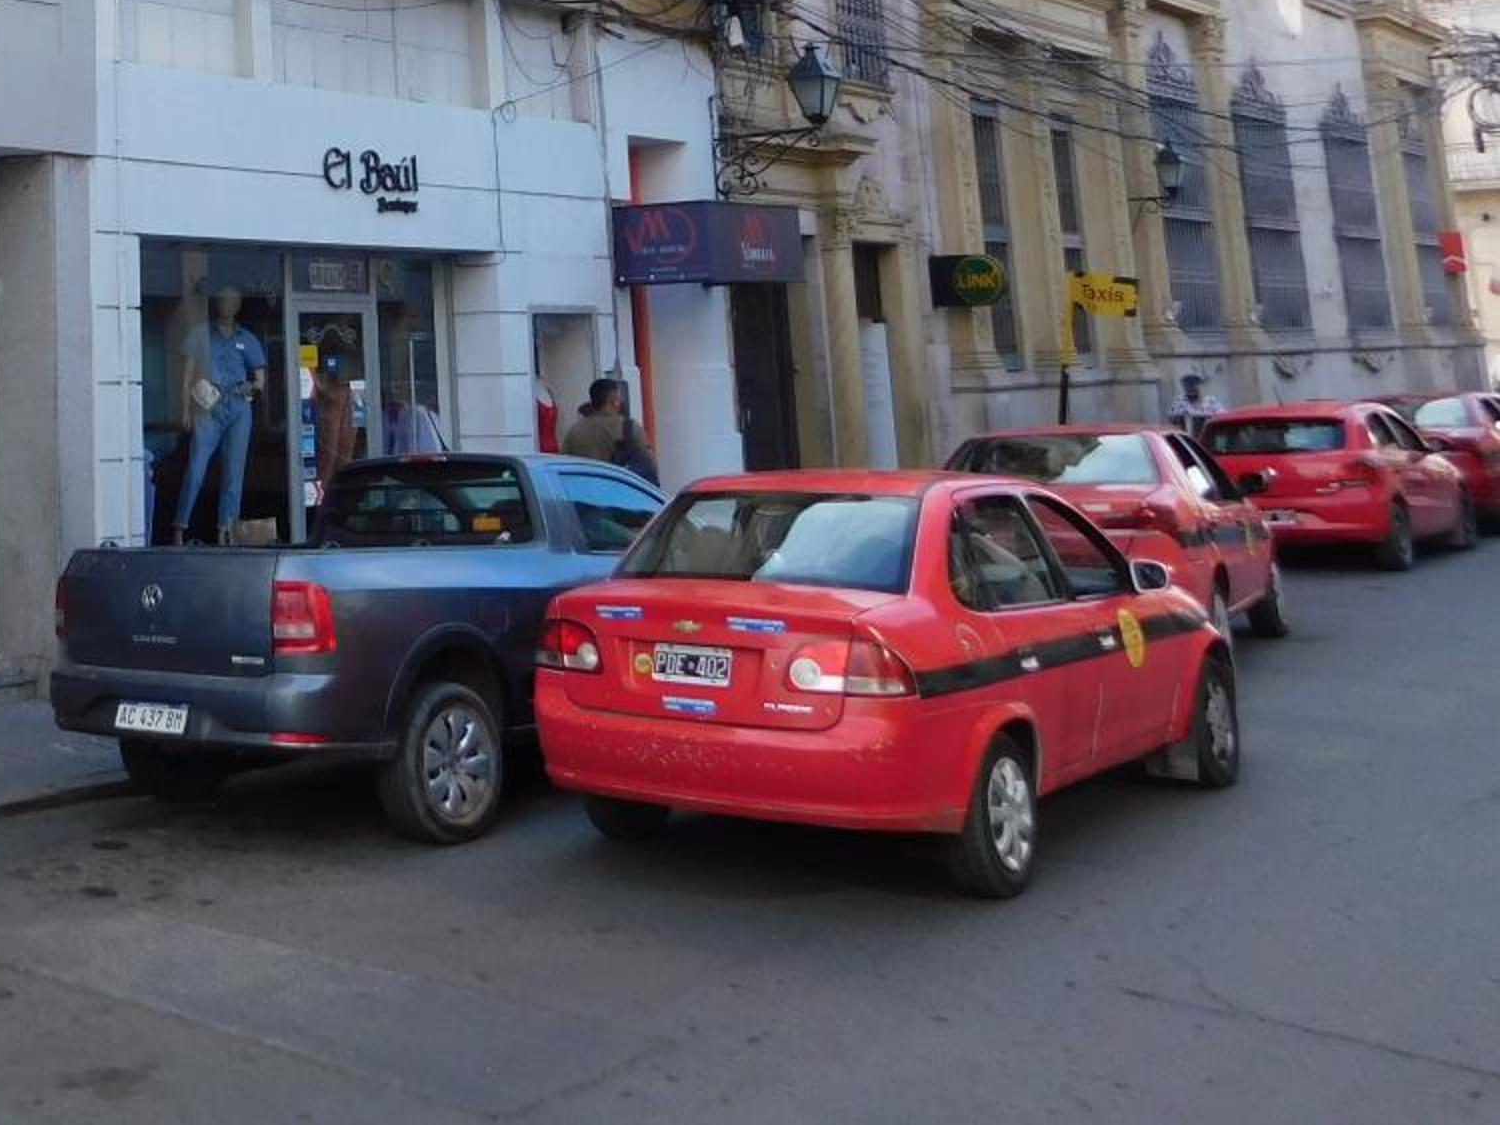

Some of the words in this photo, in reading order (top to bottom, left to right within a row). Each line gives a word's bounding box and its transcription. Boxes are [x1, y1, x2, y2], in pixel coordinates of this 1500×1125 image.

[323, 147, 352, 190] El
[360, 150, 419, 194] Baúl
[1082, 284, 1125, 303] Taxis
